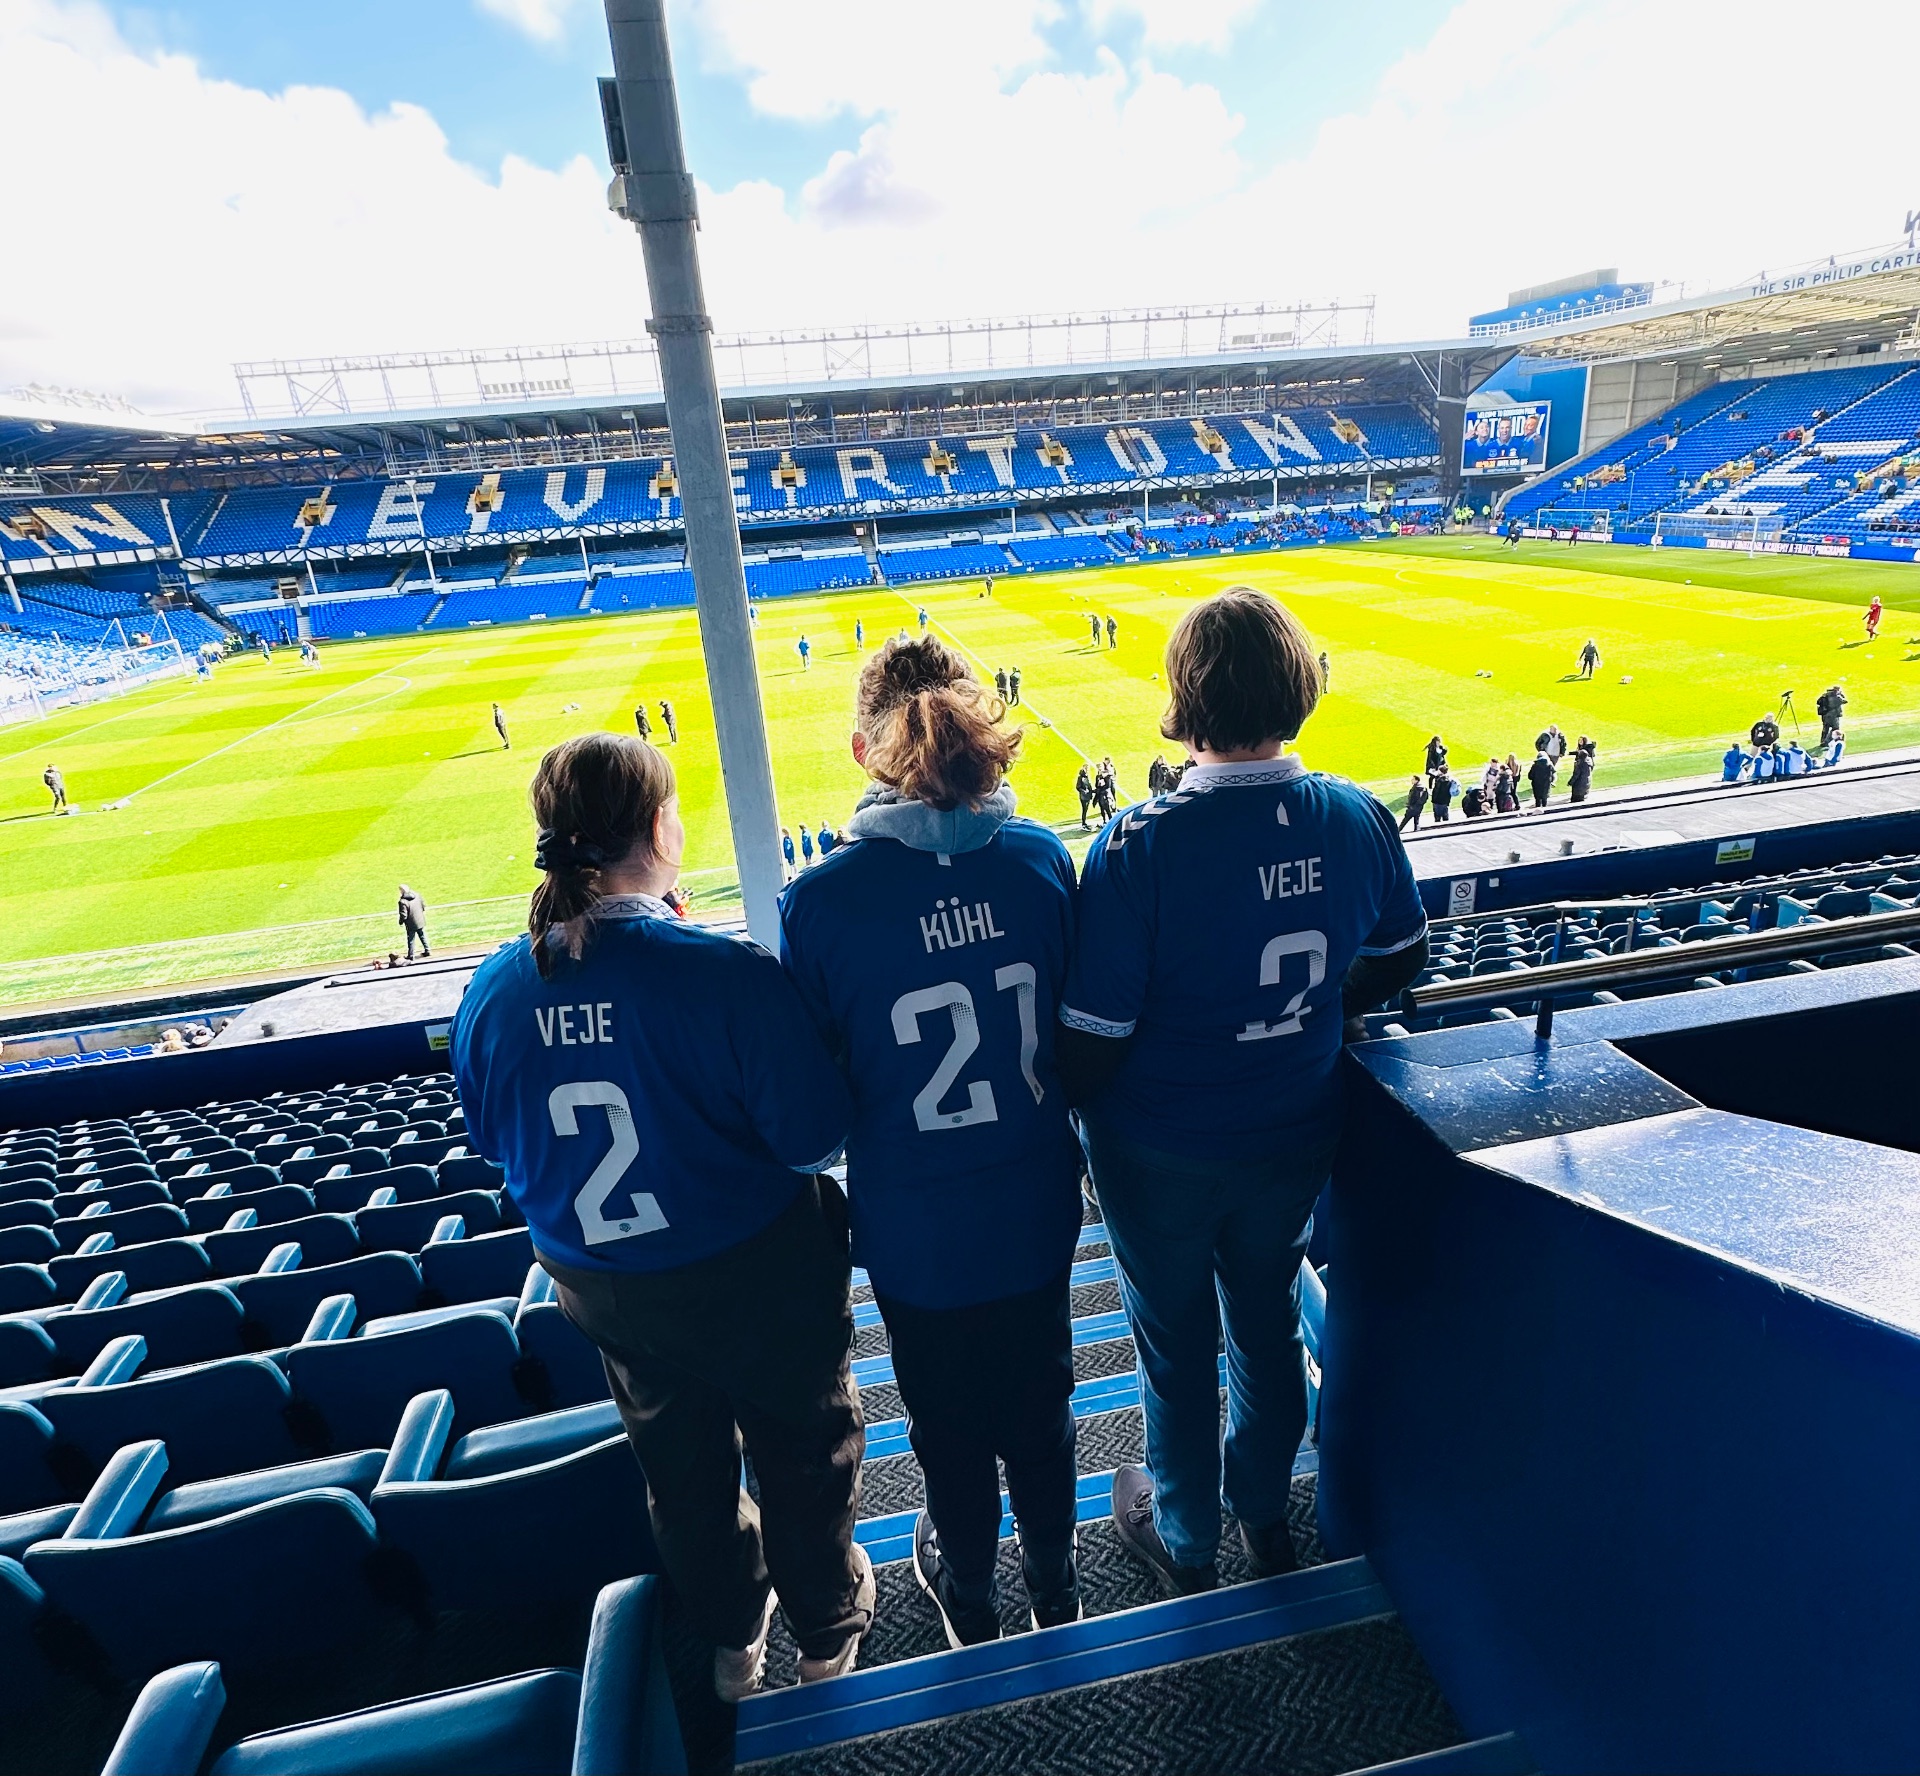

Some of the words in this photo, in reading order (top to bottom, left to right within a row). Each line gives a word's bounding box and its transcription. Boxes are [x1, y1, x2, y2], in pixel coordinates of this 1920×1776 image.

[1752, 283, 1776, 297] THE
[1783, 277, 1805, 291] SIR
[1812, 265, 1862, 284] PHILIP
[1258, 856, 1323, 900] VEJE
[919, 896, 1005, 953] KÜHL
[535, 1002, 614, 1047] VEJE
[548, 1080, 670, 1246] 2
